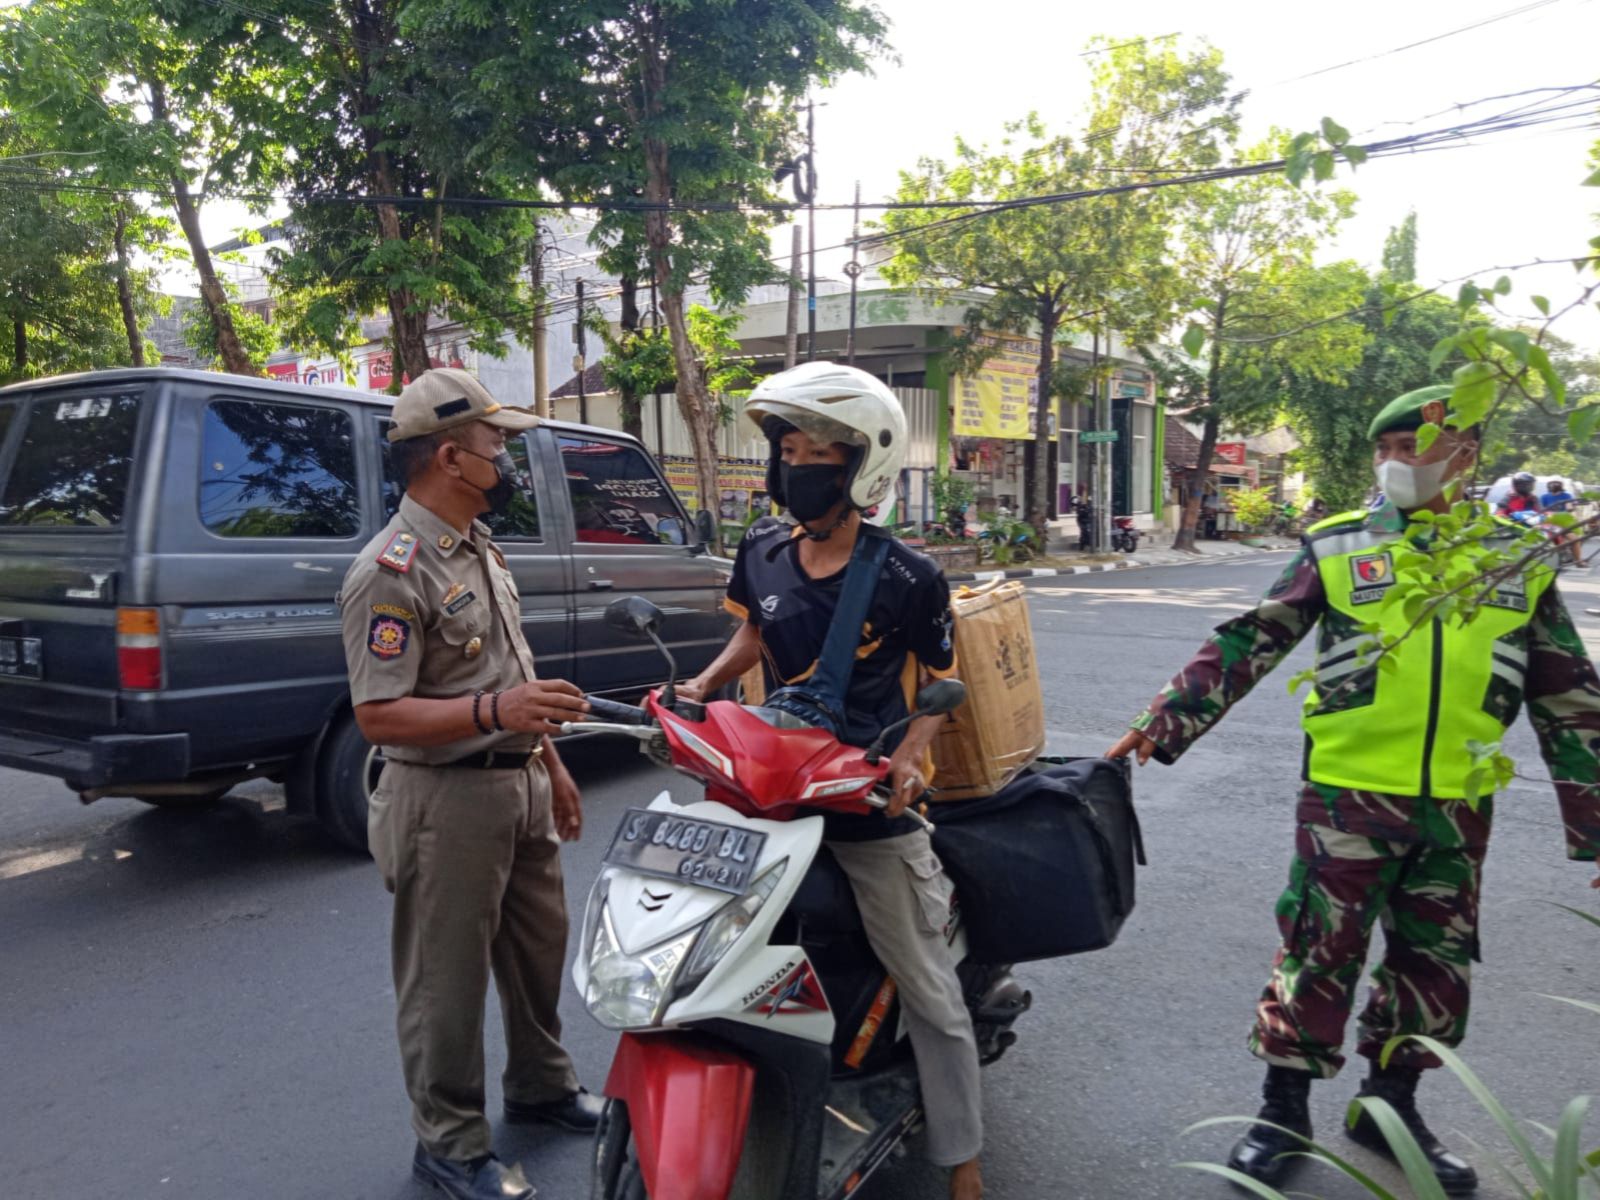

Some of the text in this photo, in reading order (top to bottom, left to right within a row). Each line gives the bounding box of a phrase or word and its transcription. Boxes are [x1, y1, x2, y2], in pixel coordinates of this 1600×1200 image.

[625, 817, 644, 841] S
[718, 830, 749, 862] BL
[741, 961, 796, 1004] HONDA
